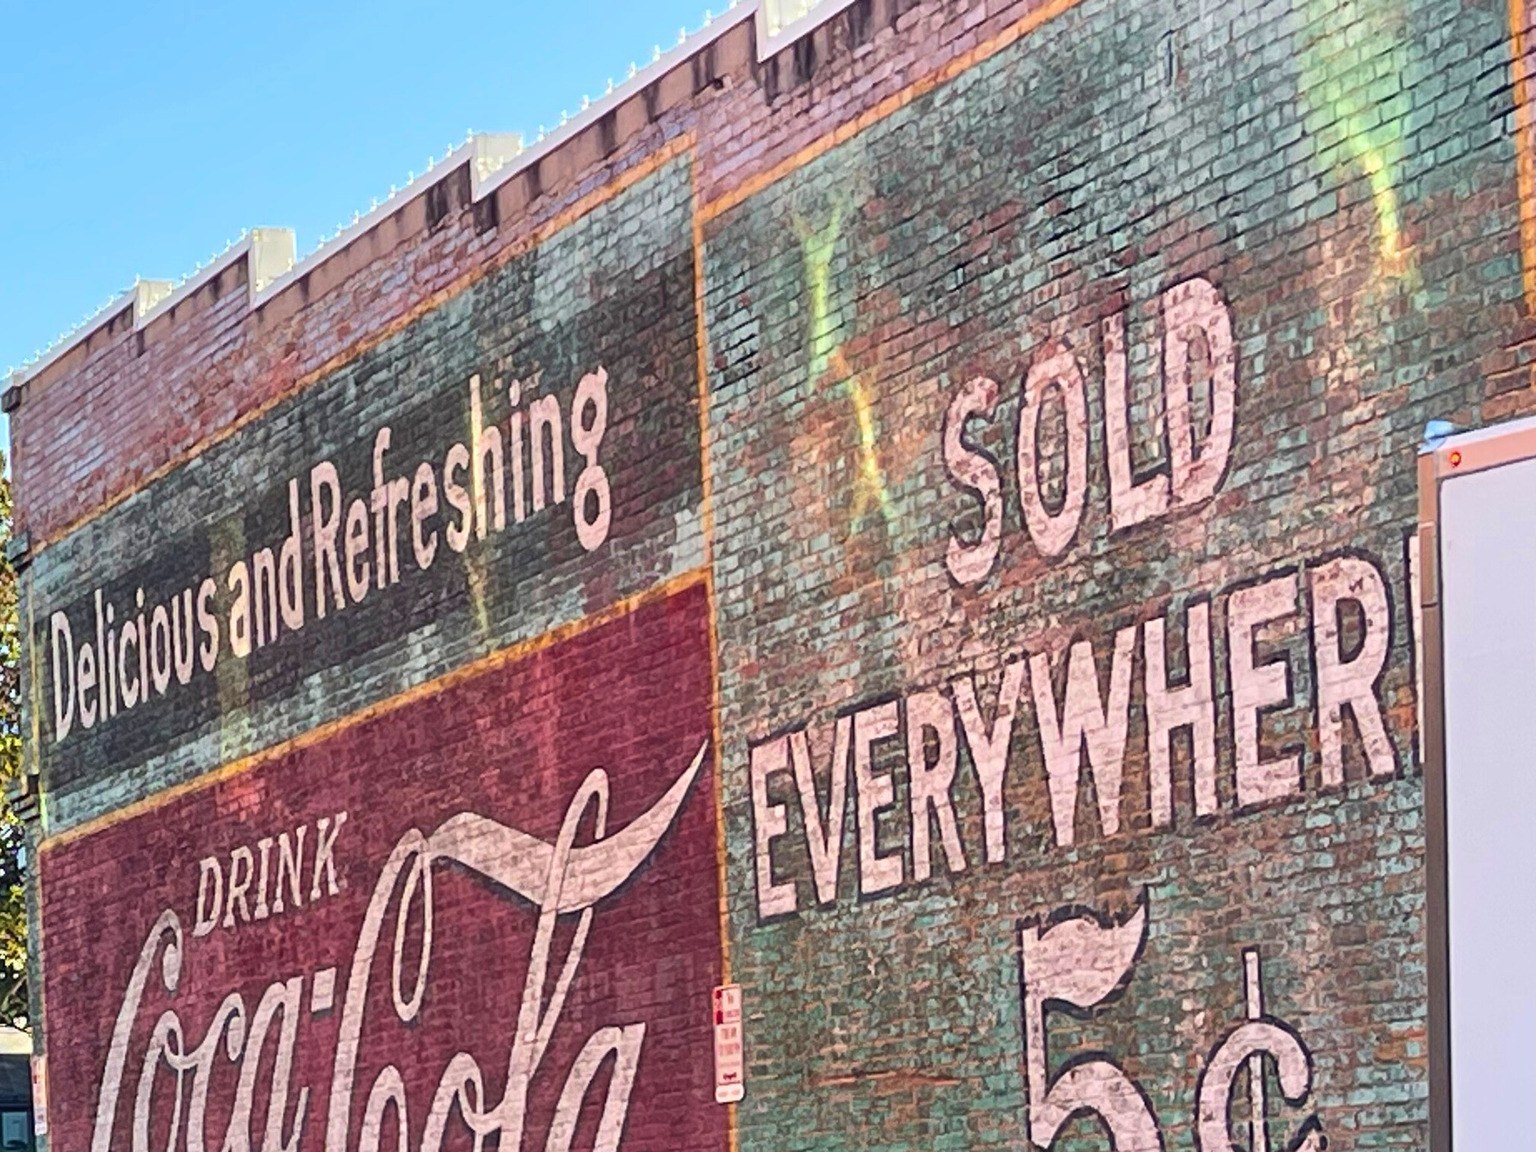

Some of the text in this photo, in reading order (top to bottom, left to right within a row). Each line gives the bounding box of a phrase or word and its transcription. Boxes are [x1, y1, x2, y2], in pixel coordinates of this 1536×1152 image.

[50, 363, 612, 743] Delicious and Refreshing
[941, 276, 1237, 586] SOLD
[192, 811, 348, 937] DRINK
[749, 545, 1425, 920] EVERYWHER
